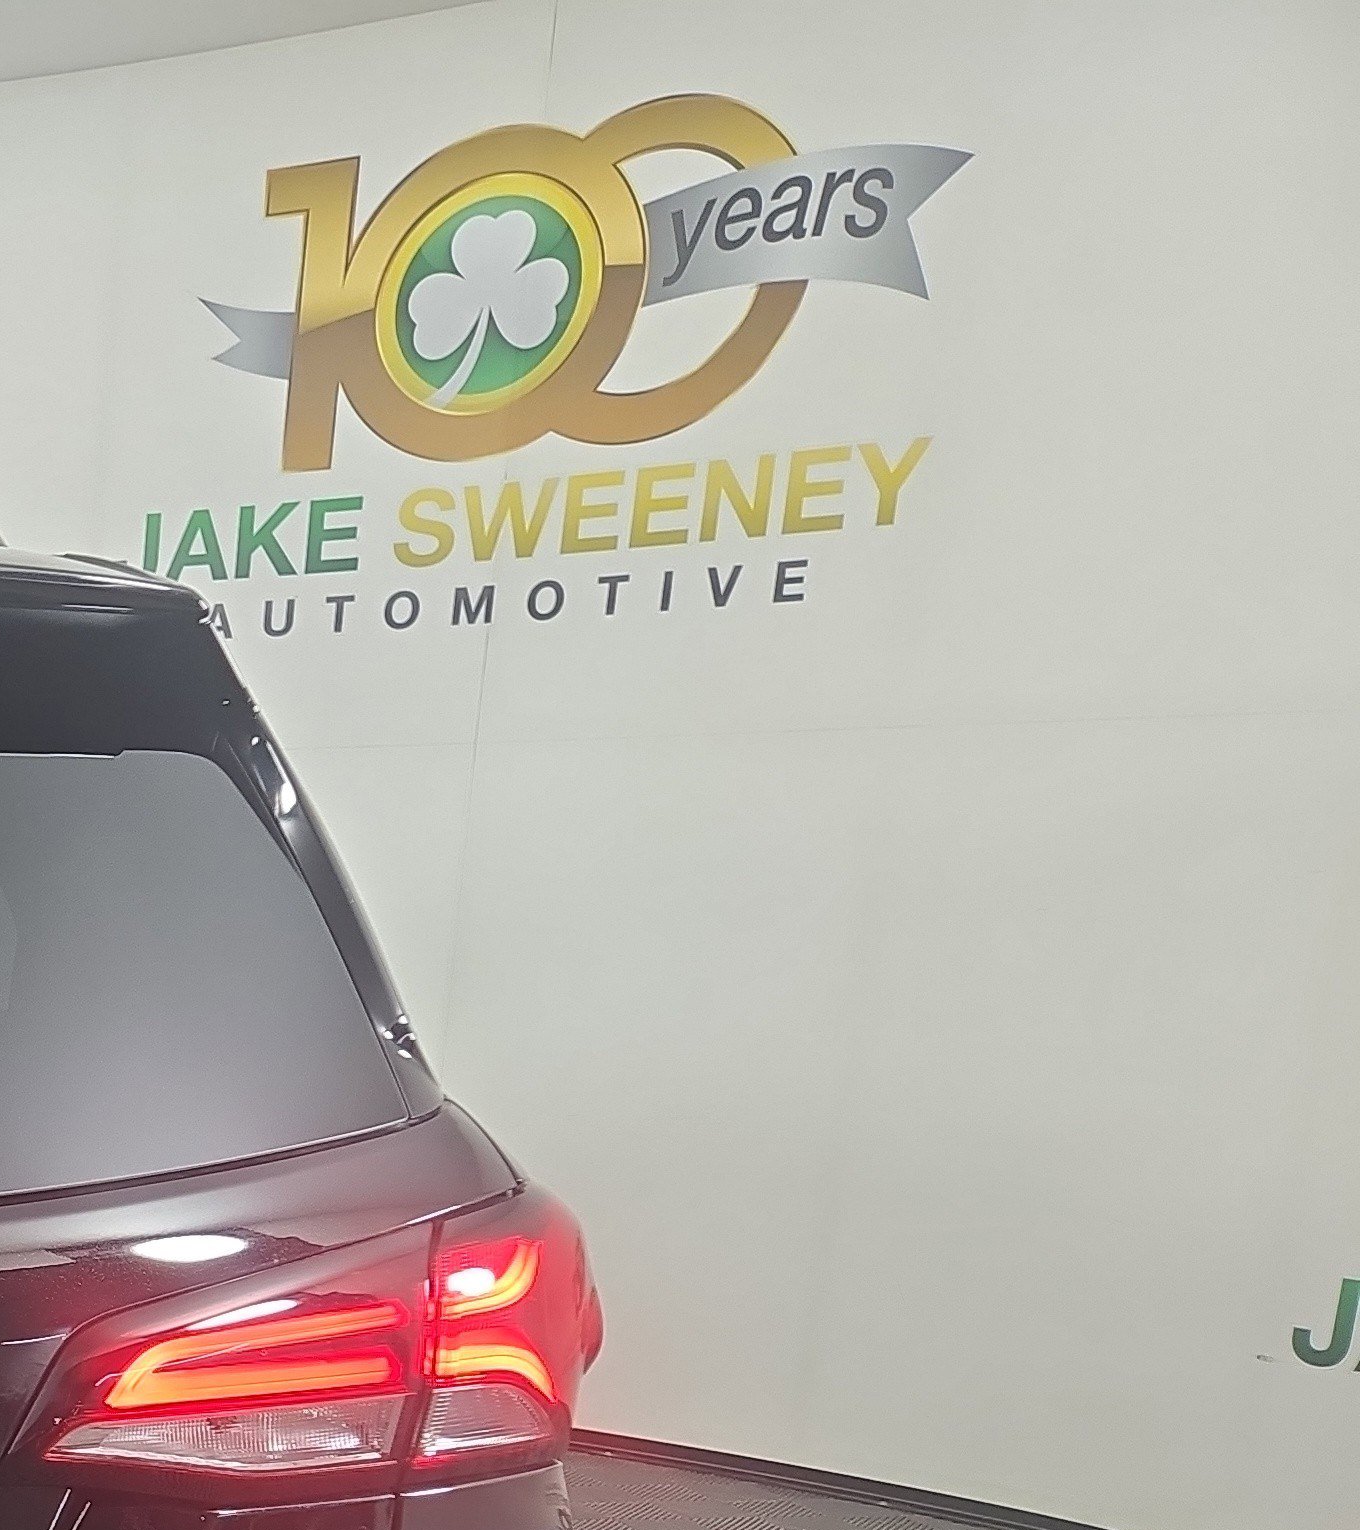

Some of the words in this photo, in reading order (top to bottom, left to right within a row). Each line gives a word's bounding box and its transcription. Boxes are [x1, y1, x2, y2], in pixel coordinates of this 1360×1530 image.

[660, 165, 896, 287] years
[392, 435, 935, 569] SWEENEY
[209, 558, 811, 641] AUTOMOTIVE
